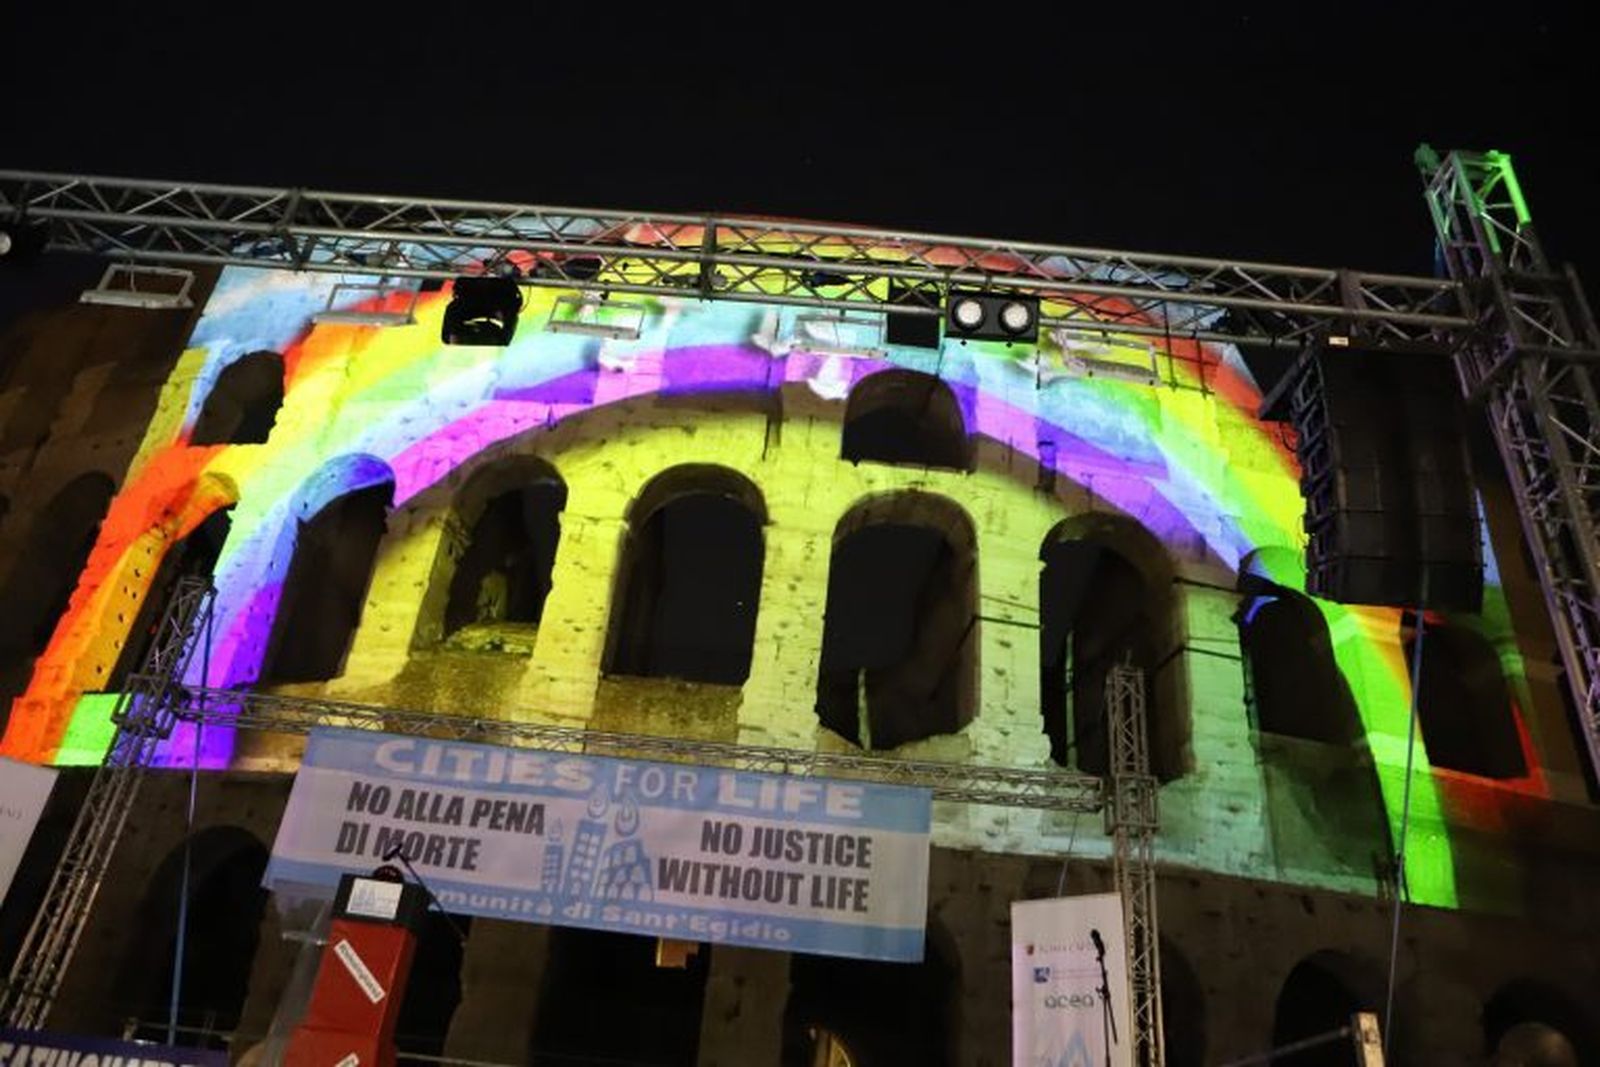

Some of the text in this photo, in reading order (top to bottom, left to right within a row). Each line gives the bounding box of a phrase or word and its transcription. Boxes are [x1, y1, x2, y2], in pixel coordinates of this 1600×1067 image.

[373, 739, 866, 818] CITIES FOR LIFE
[347, 781, 546, 836] NO ALLA PENA
[334, 821, 482, 871] DI MORTE
[701, 820, 873, 869] NO JUSTICE
[658, 858, 870, 913] WITHOUT LIFE
[437, 889, 791, 941] munità di Sant'Egidio
